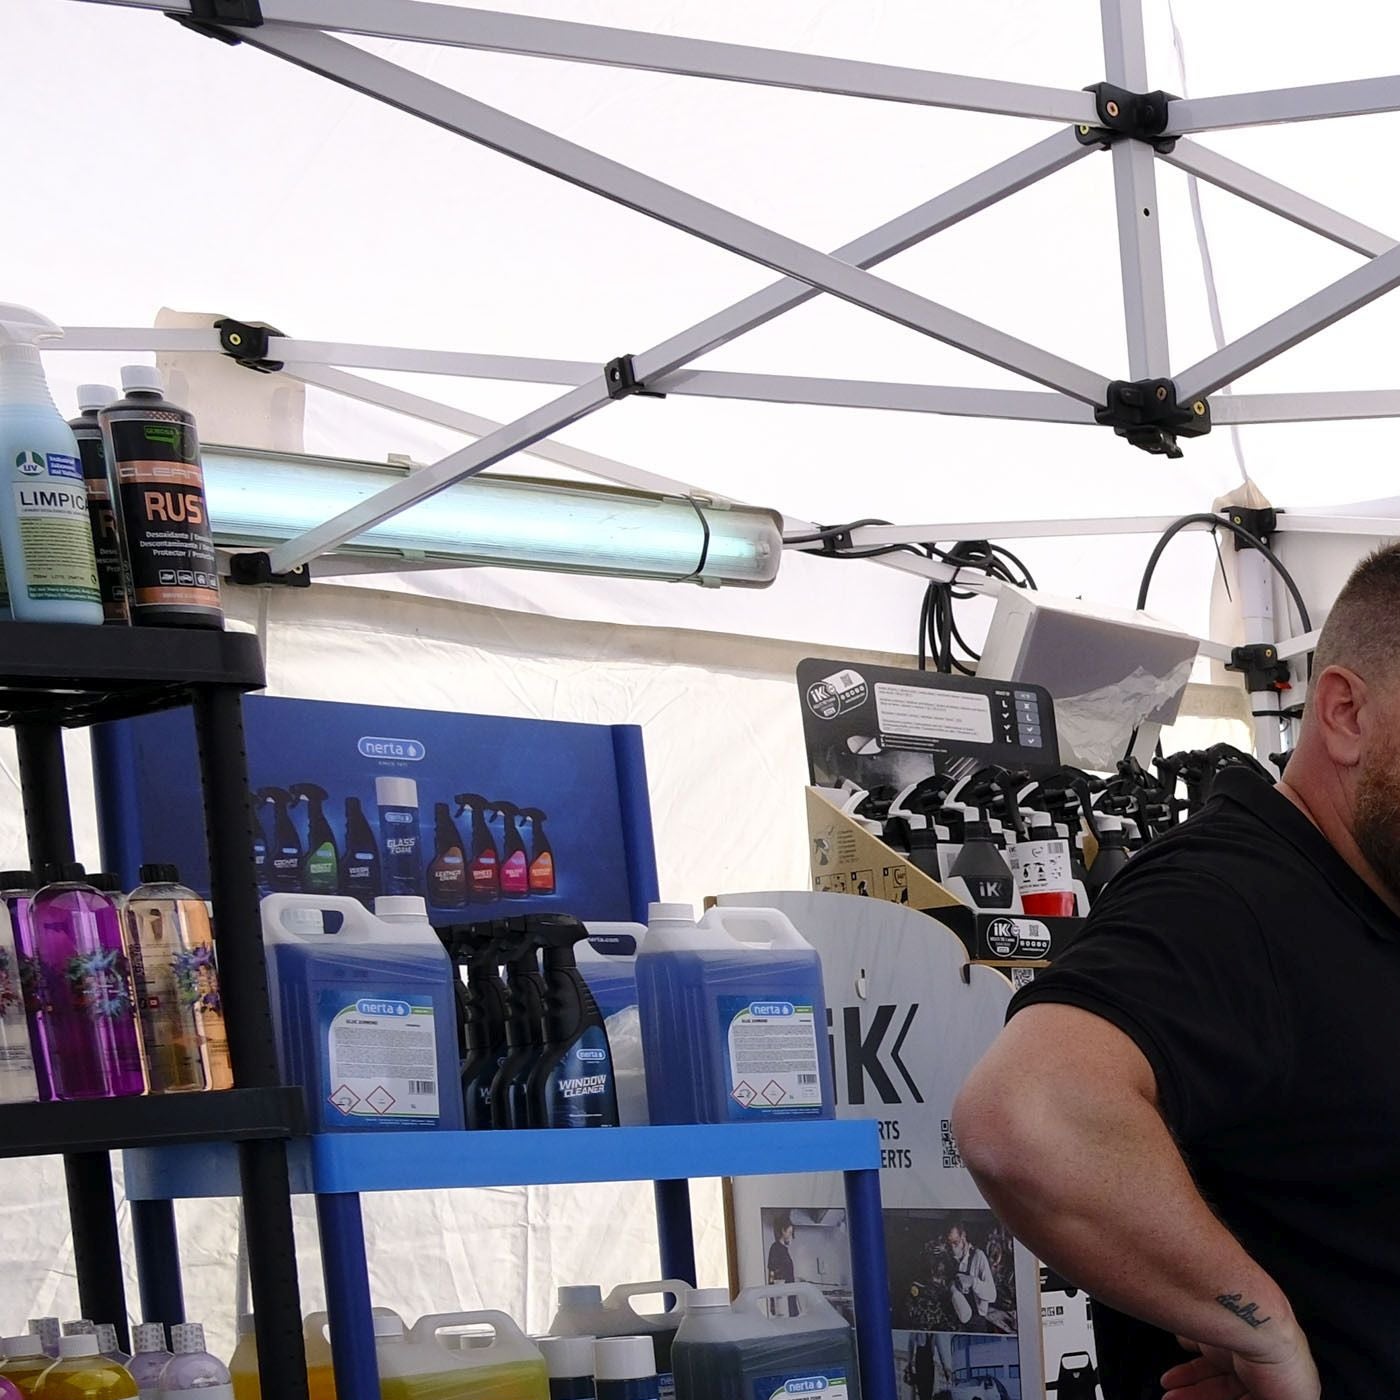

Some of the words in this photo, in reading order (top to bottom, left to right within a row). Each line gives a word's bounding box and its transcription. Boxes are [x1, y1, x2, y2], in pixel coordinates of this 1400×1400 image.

[20, 491, 89, 511] LIMPIC
[144, 491, 204, 524] RUS
[366, 741, 403, 756] nerta
[362, 1002, 394, 1015] nerta
[754, 1003, 781, 1015] nerta
[558, 1075, 606, 1091] WINDOW
[564, 1085, 605, 1099] CLEANER
[879, 1150, 912, 1169] ERTS
[789, 1381, 815, 1394] nerta
